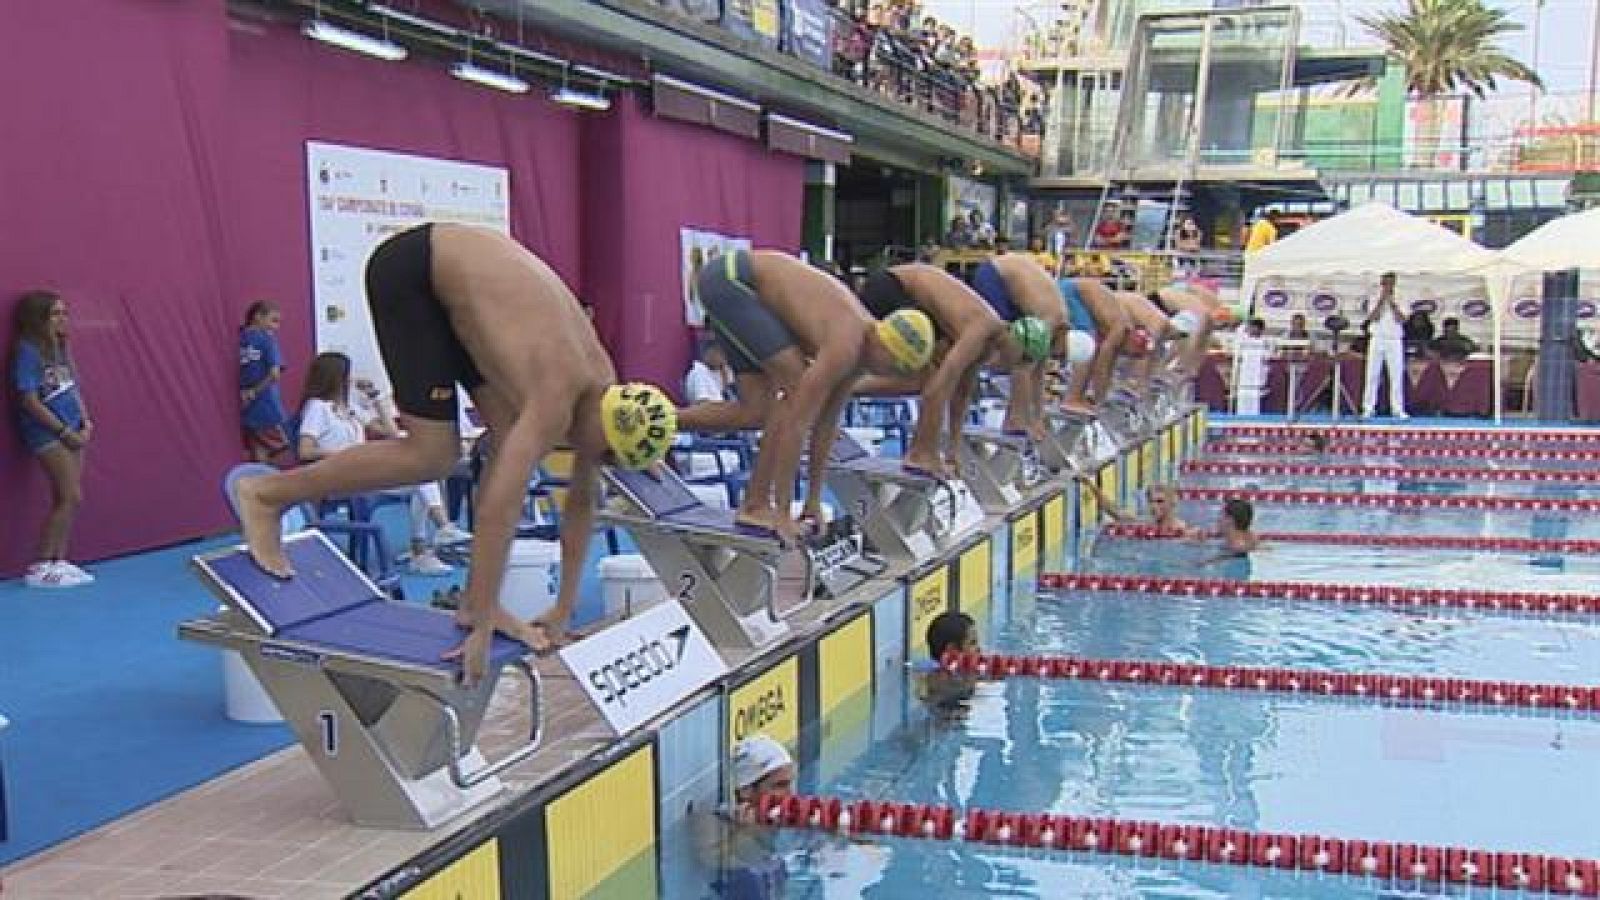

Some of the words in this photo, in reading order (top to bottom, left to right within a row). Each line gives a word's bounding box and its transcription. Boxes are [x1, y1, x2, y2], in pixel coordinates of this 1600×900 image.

[679, 574, 697, 600] 2
[588, 635, 673, 707] speedo
[321, 712, 337, 753] 1
[734, 684, 785, 741] OMEGA
